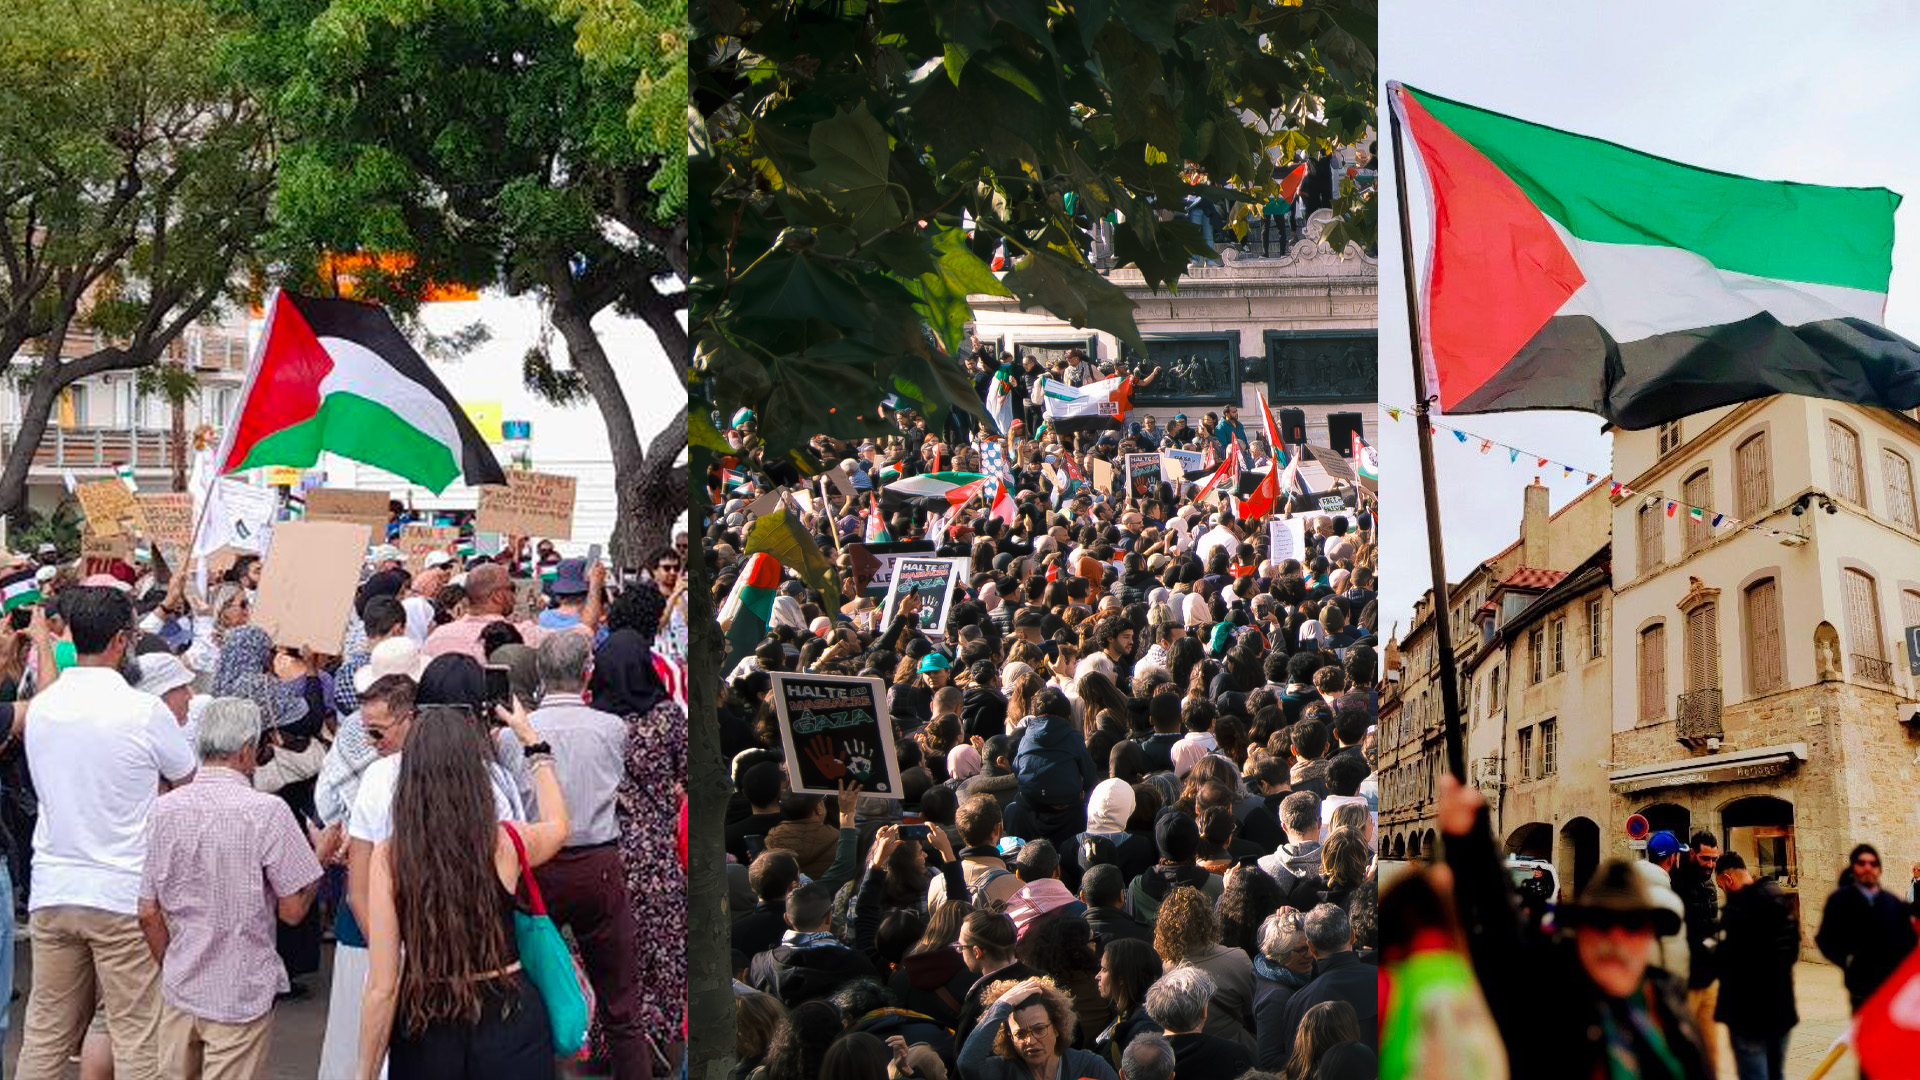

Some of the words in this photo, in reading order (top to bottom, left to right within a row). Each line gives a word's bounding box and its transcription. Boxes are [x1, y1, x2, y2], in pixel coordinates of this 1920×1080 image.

[903, 563, 938, 572] HALTE
[897, 576, 946, 592] GAZA
[787, 685, 848, 699] HALTE
[850, 686, 868, 697] AU
[788, 695, 873, 711] MASSACRE
[792, 708, 875, 734] GAZA
